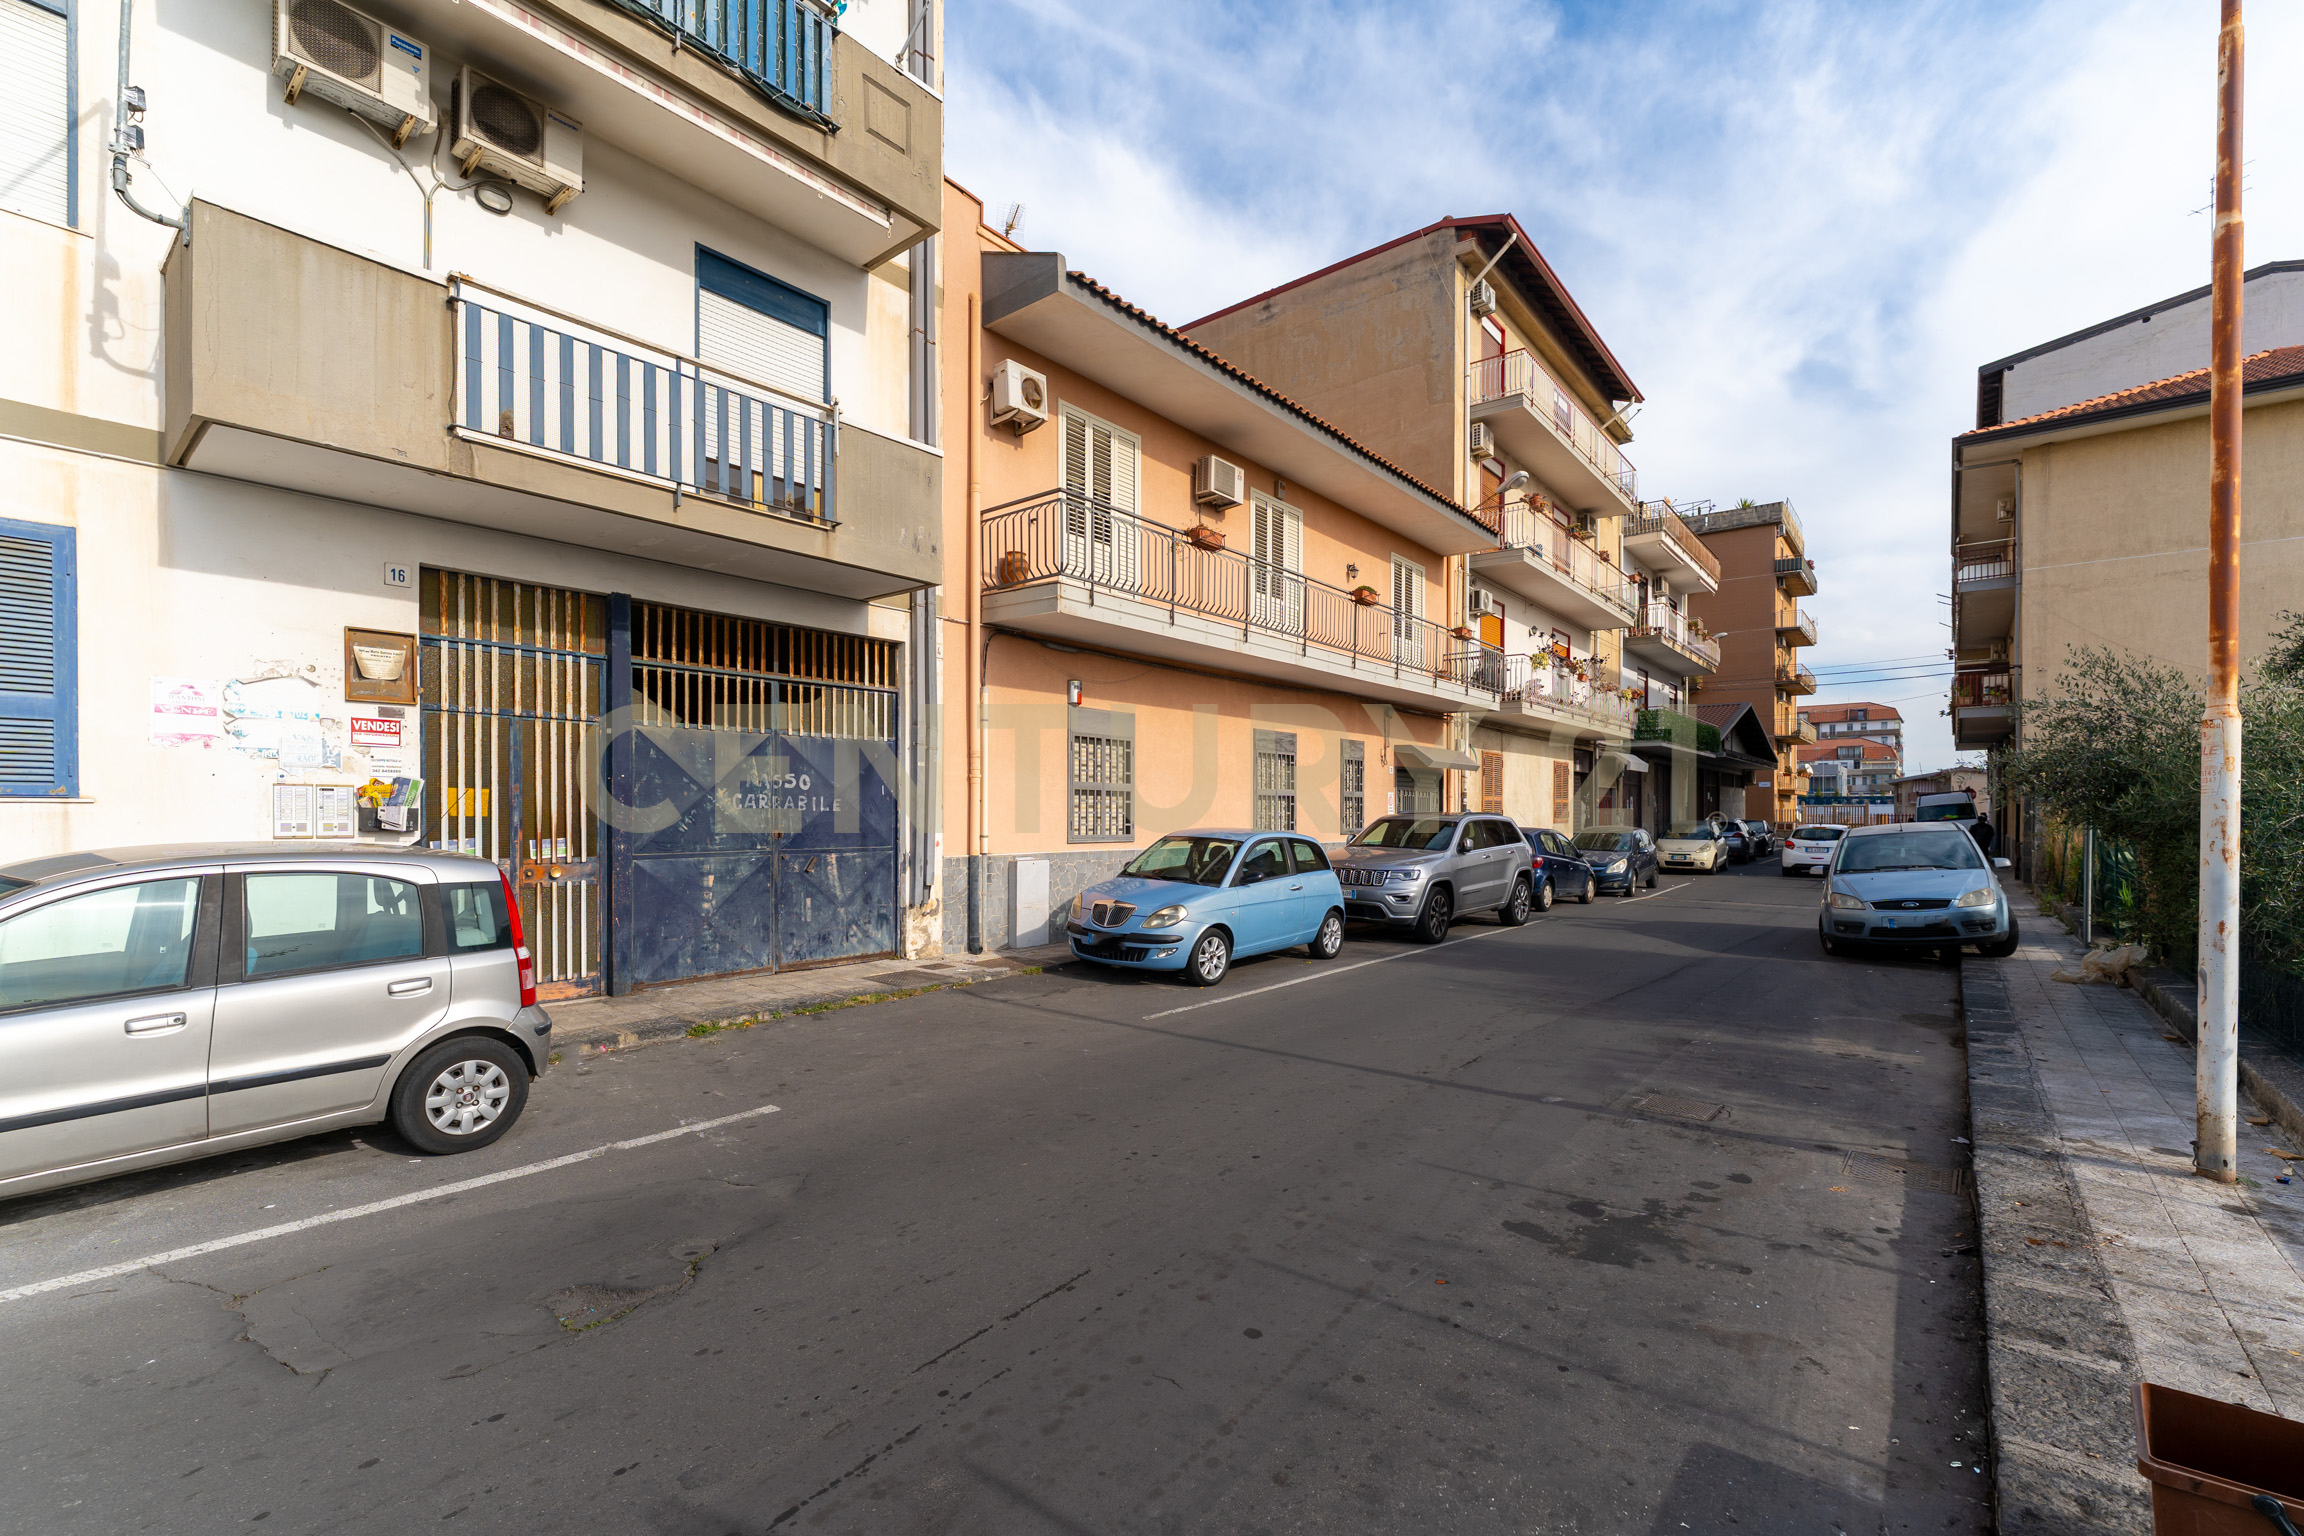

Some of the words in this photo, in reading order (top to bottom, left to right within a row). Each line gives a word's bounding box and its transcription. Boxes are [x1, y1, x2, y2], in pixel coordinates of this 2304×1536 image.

[392, 37, 420, 54] Panasonic
[548, 112, 578, 131] Panasonic
[391, 568, 405, 582] 16
[352, 720, 400, 732] VENDESI
[732, 793, 842, 812] CARRABILE
